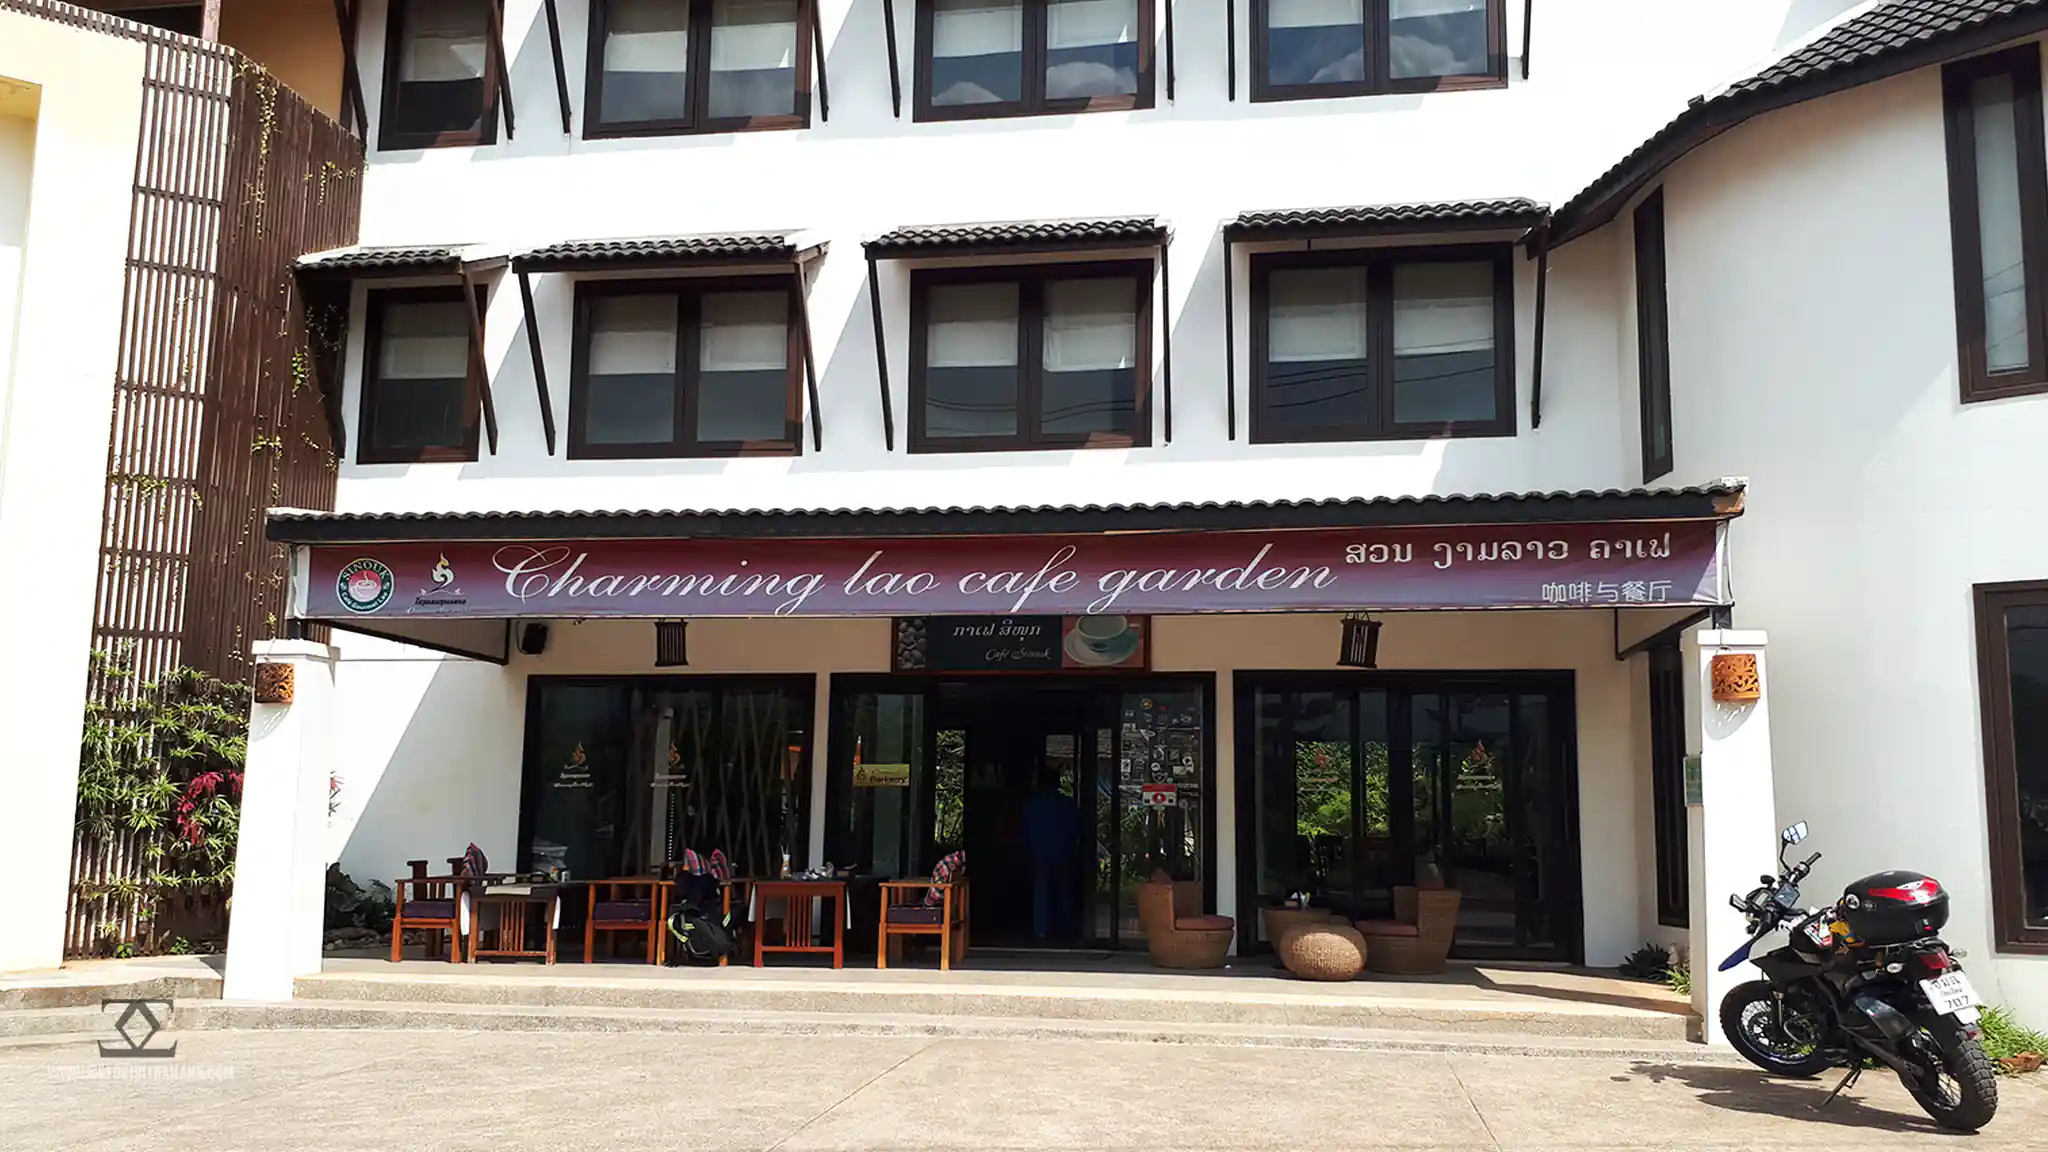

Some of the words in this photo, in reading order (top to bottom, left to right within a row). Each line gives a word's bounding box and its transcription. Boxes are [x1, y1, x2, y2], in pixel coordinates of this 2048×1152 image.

[1346, 543, 1412, 564] ສວນ
[1433, 539, 1569, 569] ງາມລາວ
[343, 560, 389, 580] SINOUK
[492, 544, 826, 616] Charming
[843, 550, 940, 595] lao
[958, 545, 1080, 613] cafe
[1086, 543, 1338, 614] garden
[1542, 579, 1672, 603] 咖啡与餐厅
[1943, 995, 1969, 1009] 707
